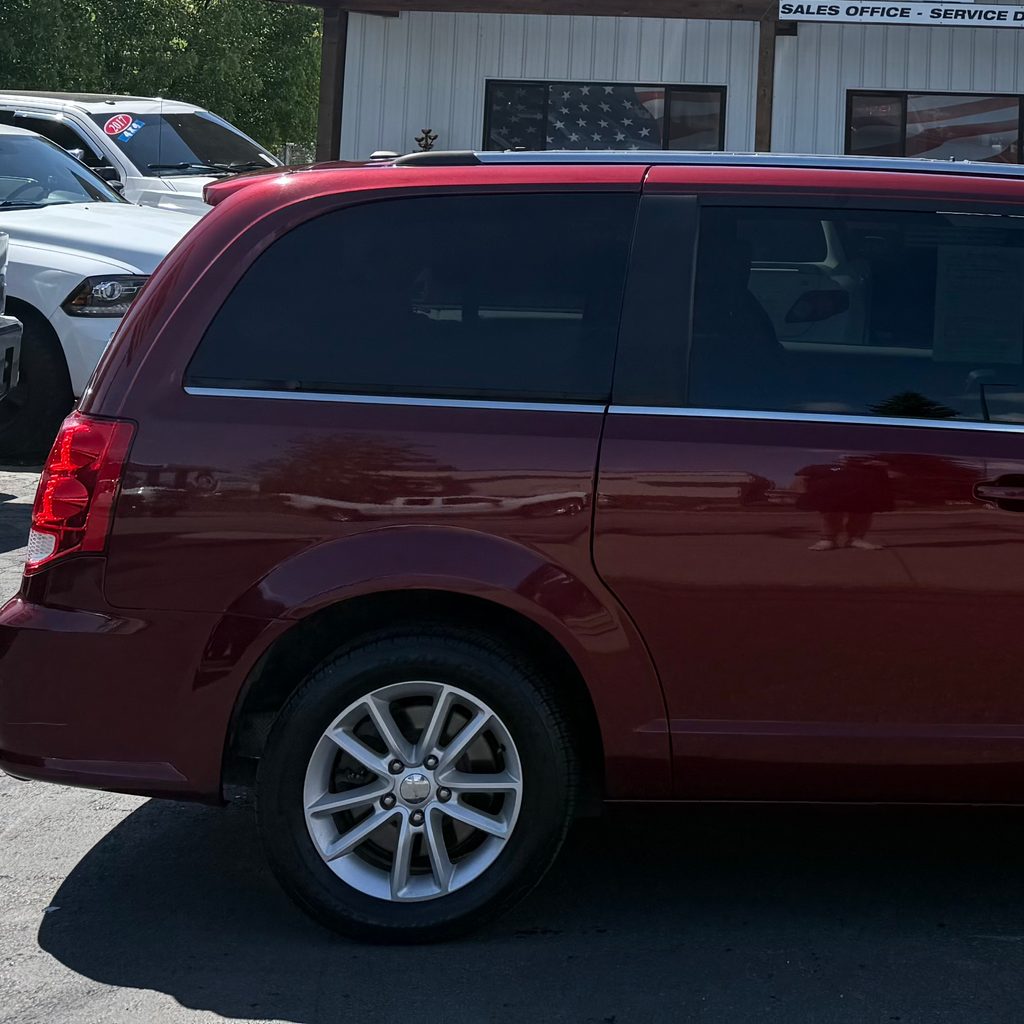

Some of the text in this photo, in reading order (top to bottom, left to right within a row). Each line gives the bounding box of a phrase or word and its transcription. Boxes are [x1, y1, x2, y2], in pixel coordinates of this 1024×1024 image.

[780, 3, 841, 16] SALES
[845, 5, 912, 18] OFFICE
[929, 8, 1009, 21] SERVICE
[108, 115, 128, 133] 2017
